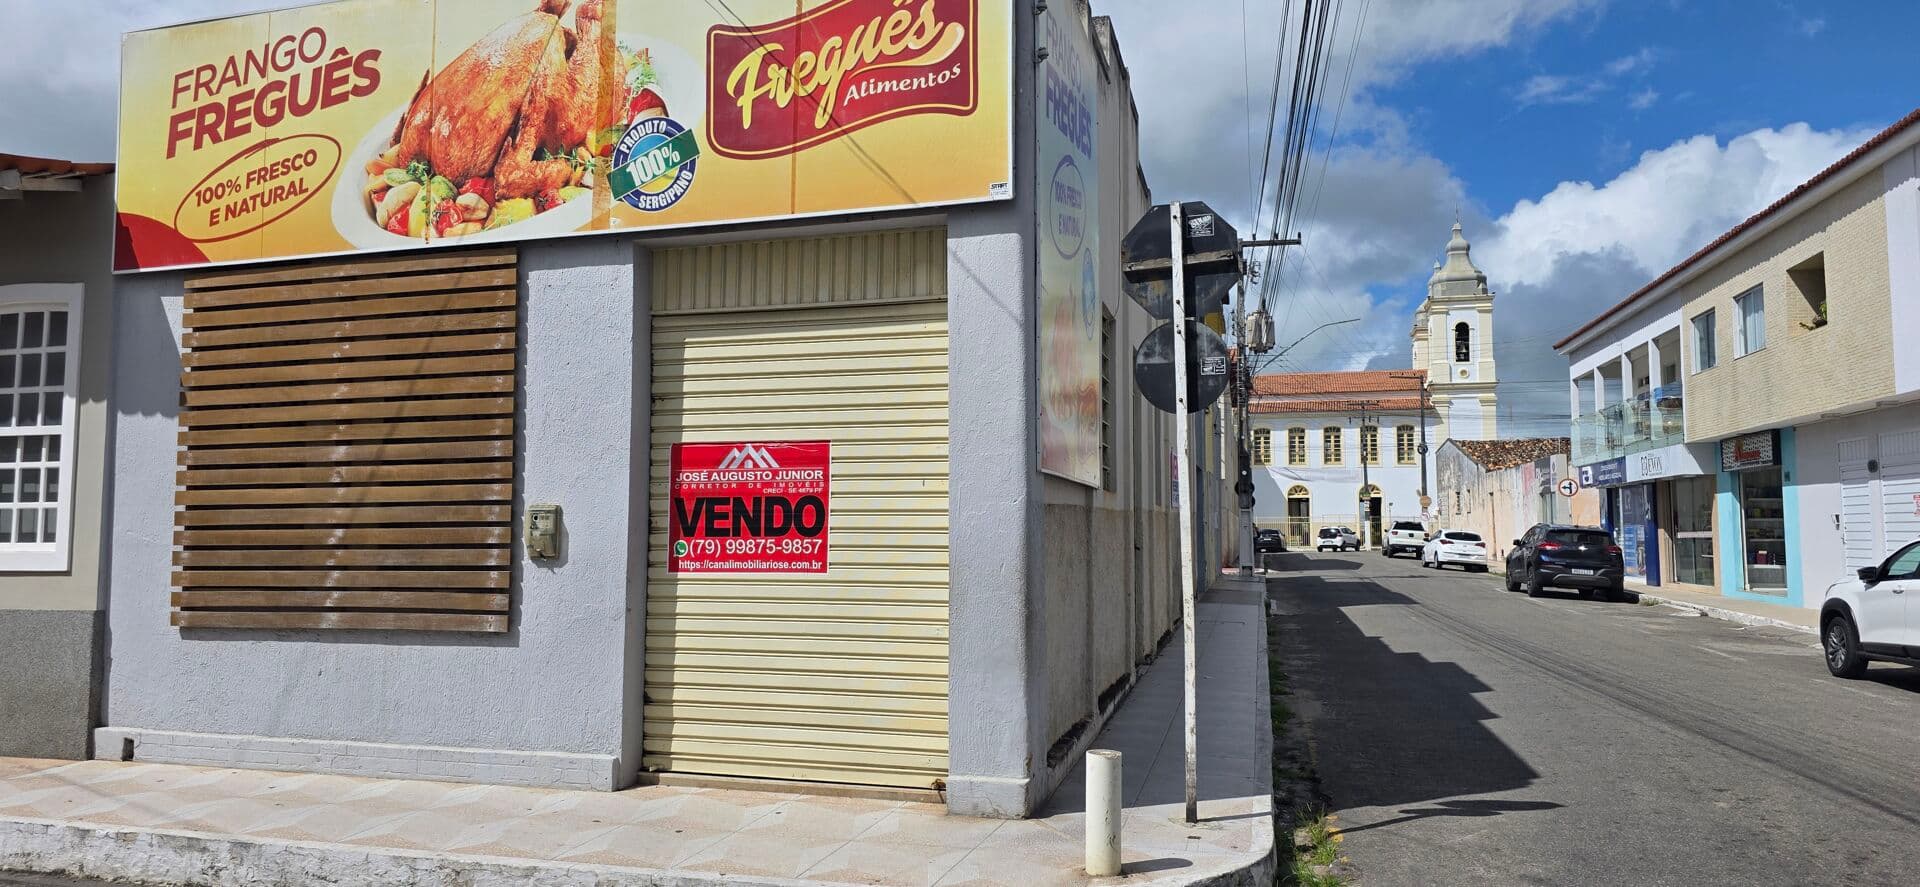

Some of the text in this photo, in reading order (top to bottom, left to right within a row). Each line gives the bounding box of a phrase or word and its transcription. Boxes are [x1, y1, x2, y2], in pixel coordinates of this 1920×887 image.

[171, 27, 327, 109] FRANGO
[843, 63, 961, 107] Alimentos
[166, 47, 382, 159] FREGUÊS
[619, 119, 667, 153] PRODUTO
[195, 149, 318, 207] 100% FRESCO
[626, 143, 680, 187] 100%
[209, 177, 309, 227] E NATURAL
[638, 170, 693, 209] SERGIPANO
[676, 470, 823, 481] JOSÉ AUGUSTO JUNIOR
[674, 495, 825, 537] VENDO
[678, 559, 822, 571] https://canalimobiliariose.com.br
[690, 539, 823, 558] (79) 99875-9857
